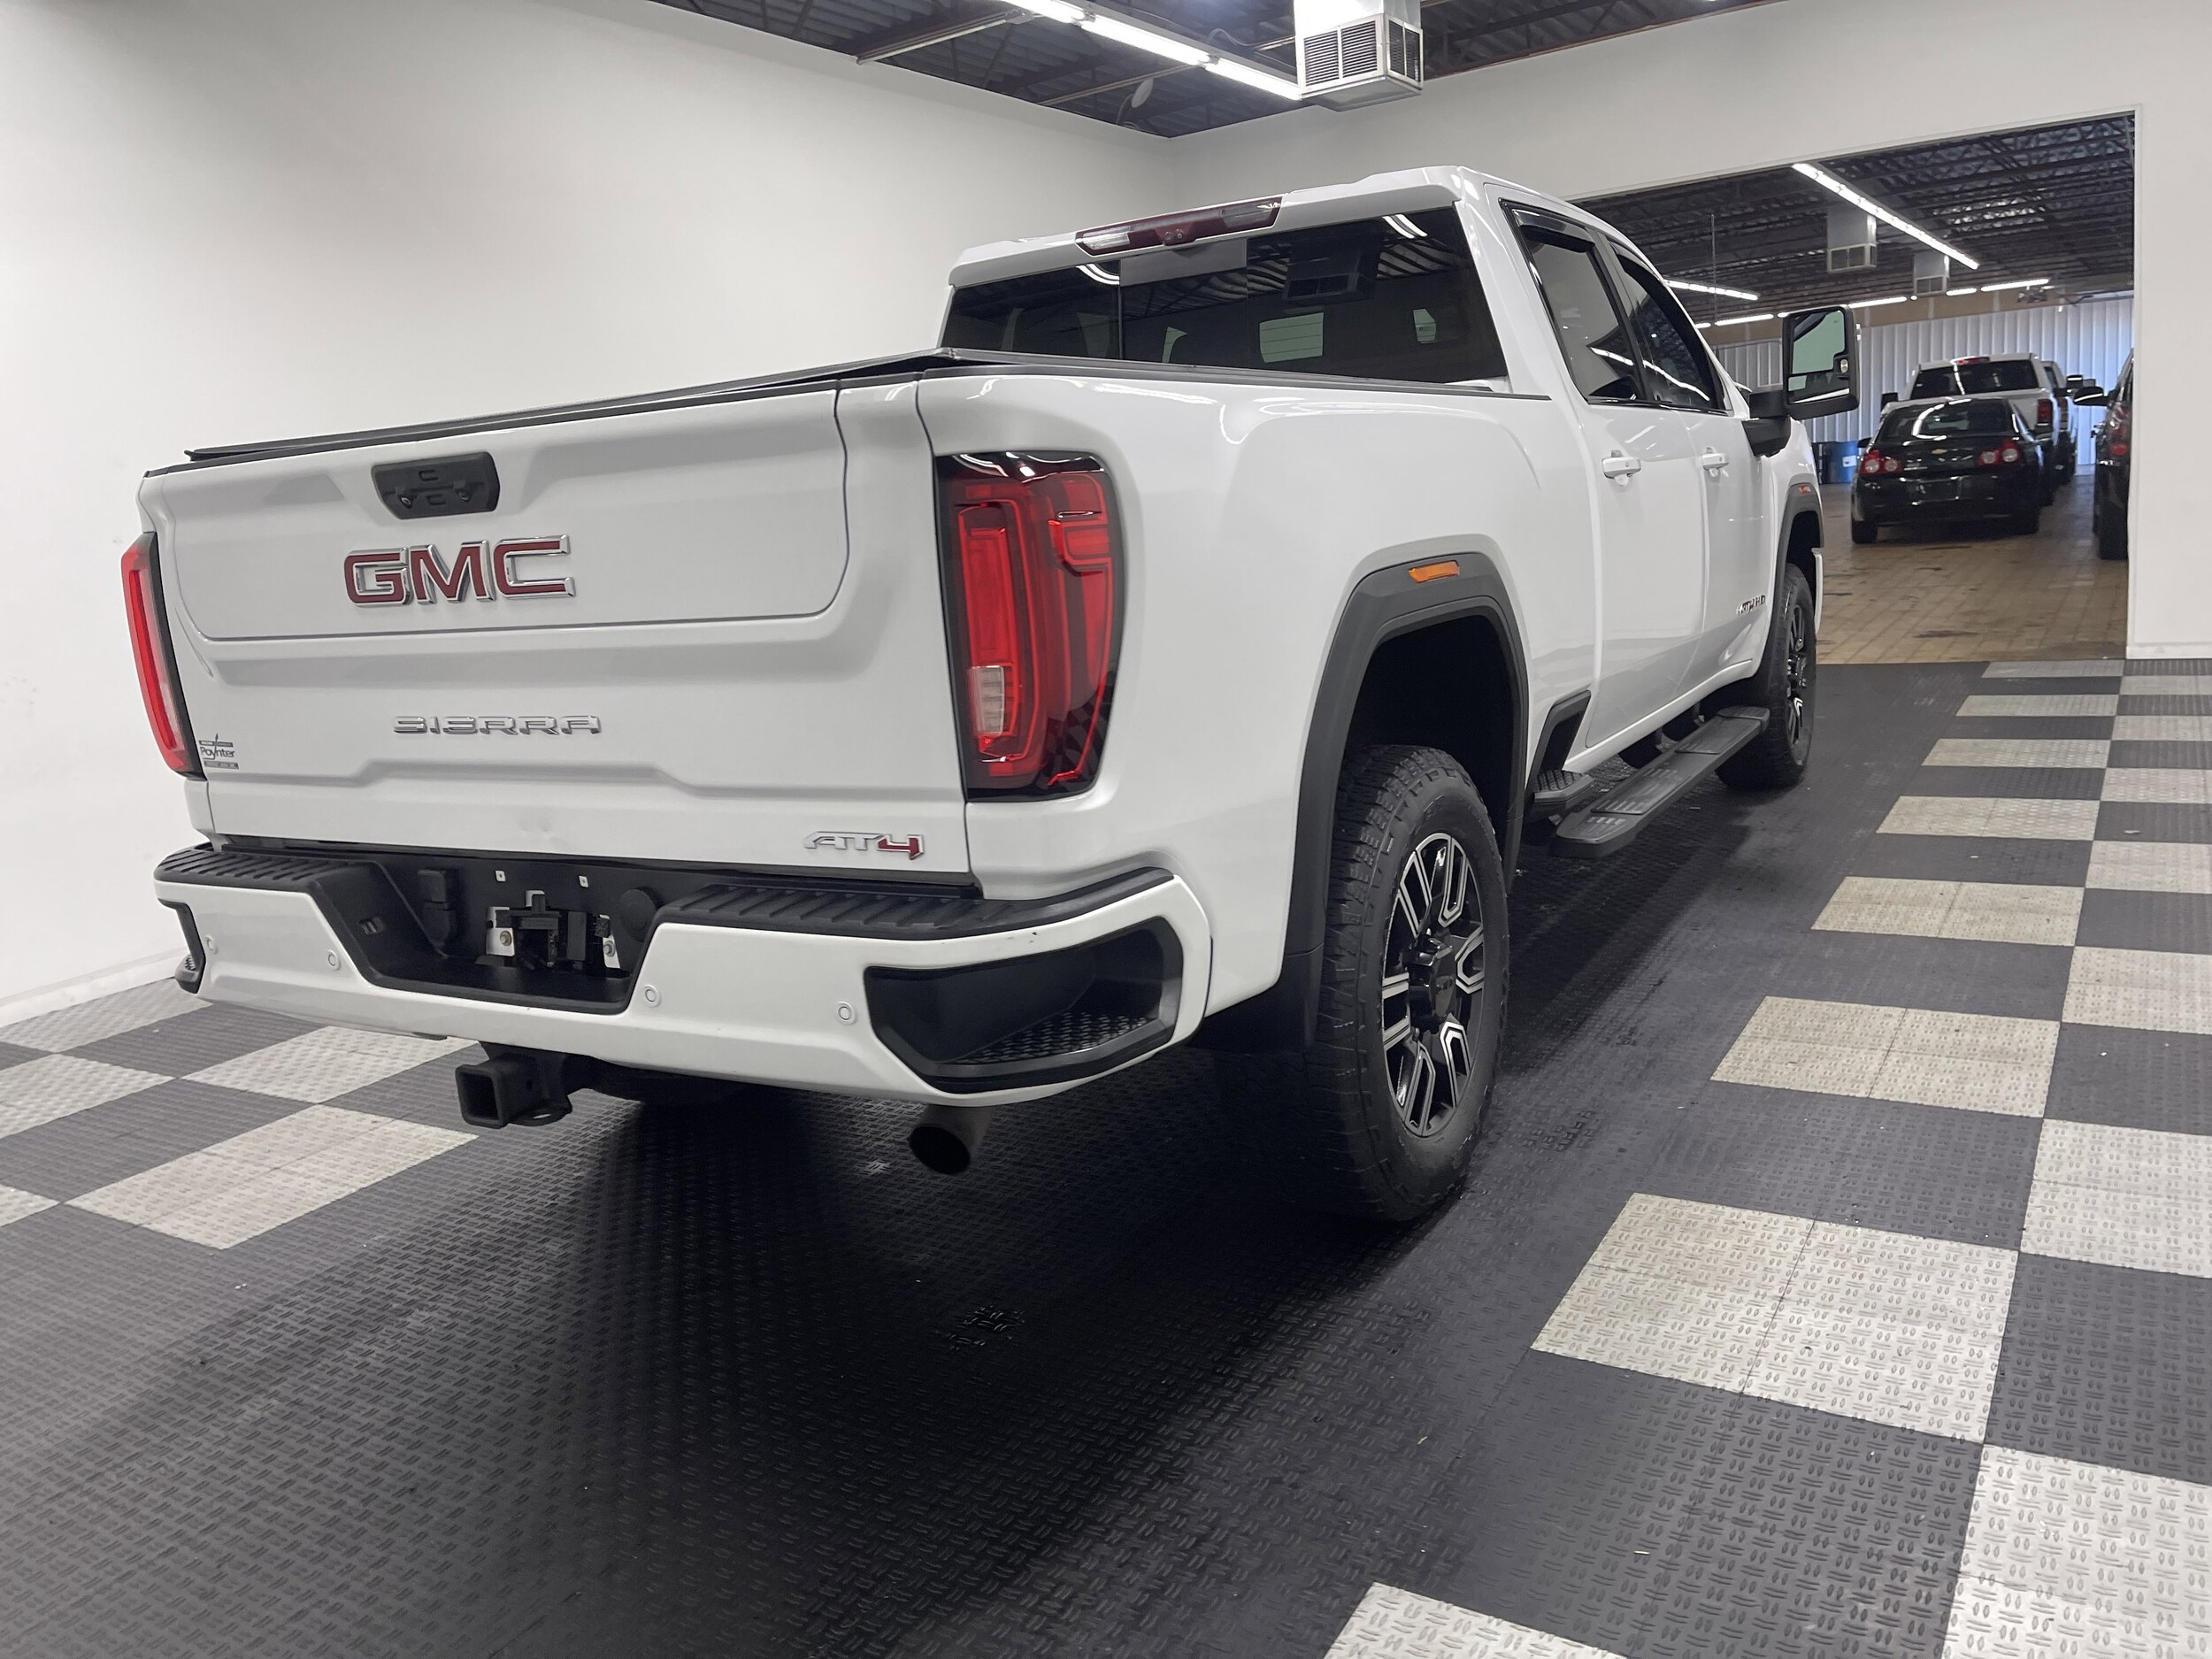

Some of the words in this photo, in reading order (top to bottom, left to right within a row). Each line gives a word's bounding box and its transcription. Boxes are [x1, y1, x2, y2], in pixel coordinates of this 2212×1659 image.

[344, 534, 576, 607] GMC
[394, 715, 602, 735] SIERRA
[804, 831, 925, 861] AT4
